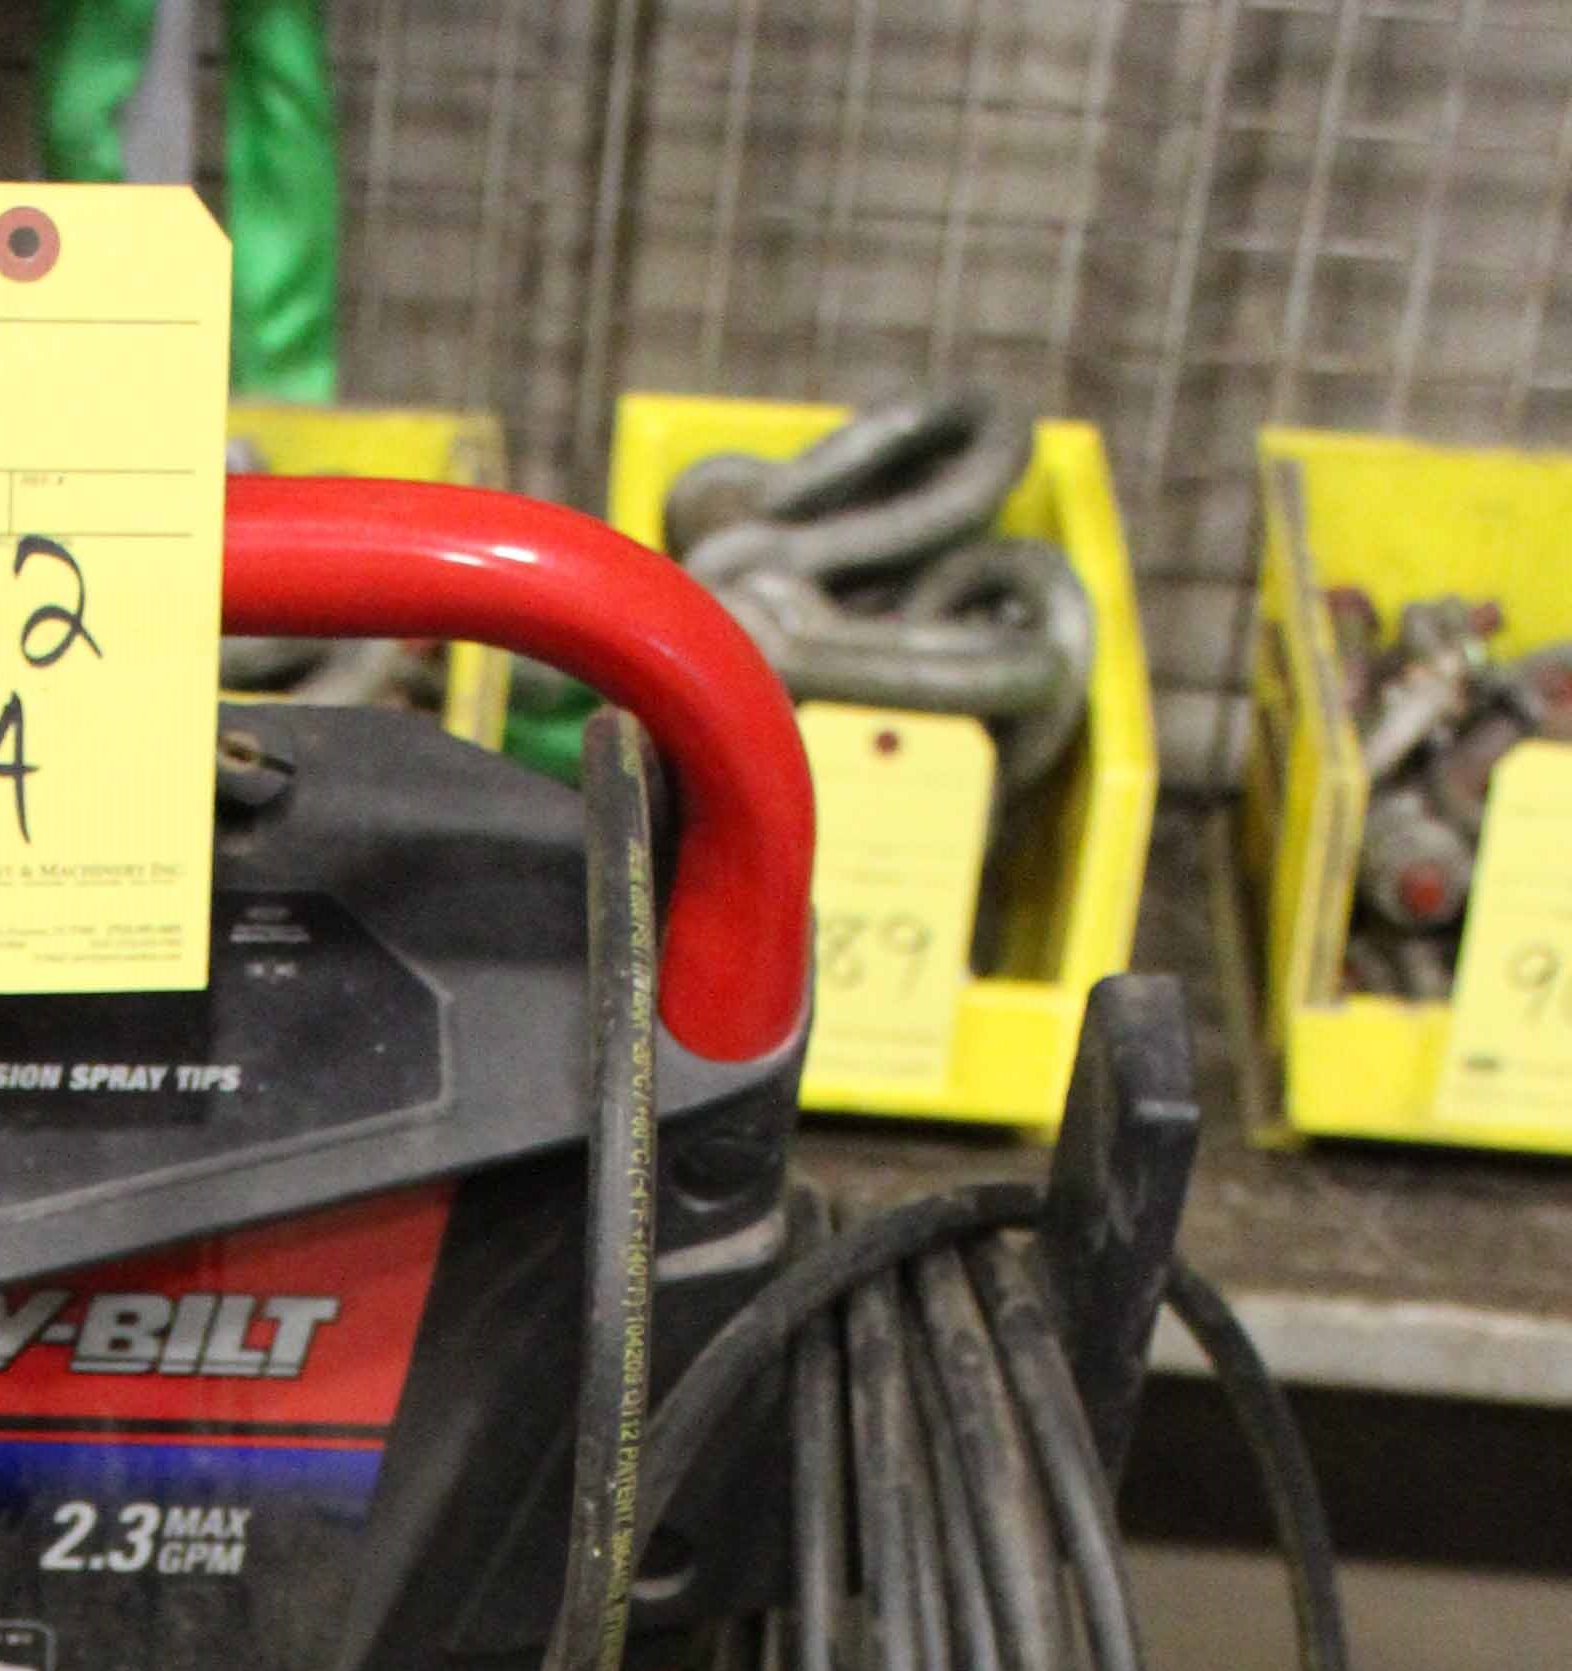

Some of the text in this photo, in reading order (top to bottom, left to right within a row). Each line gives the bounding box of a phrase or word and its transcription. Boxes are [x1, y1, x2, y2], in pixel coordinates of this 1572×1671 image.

[69, 1062, 167, 1091] SPRAY
[176, 1064, 242, 1092] TIPS
[40, 1501, 251, 1573] 2.3 MAX
[157, 1543, 246, 1576] GPM
